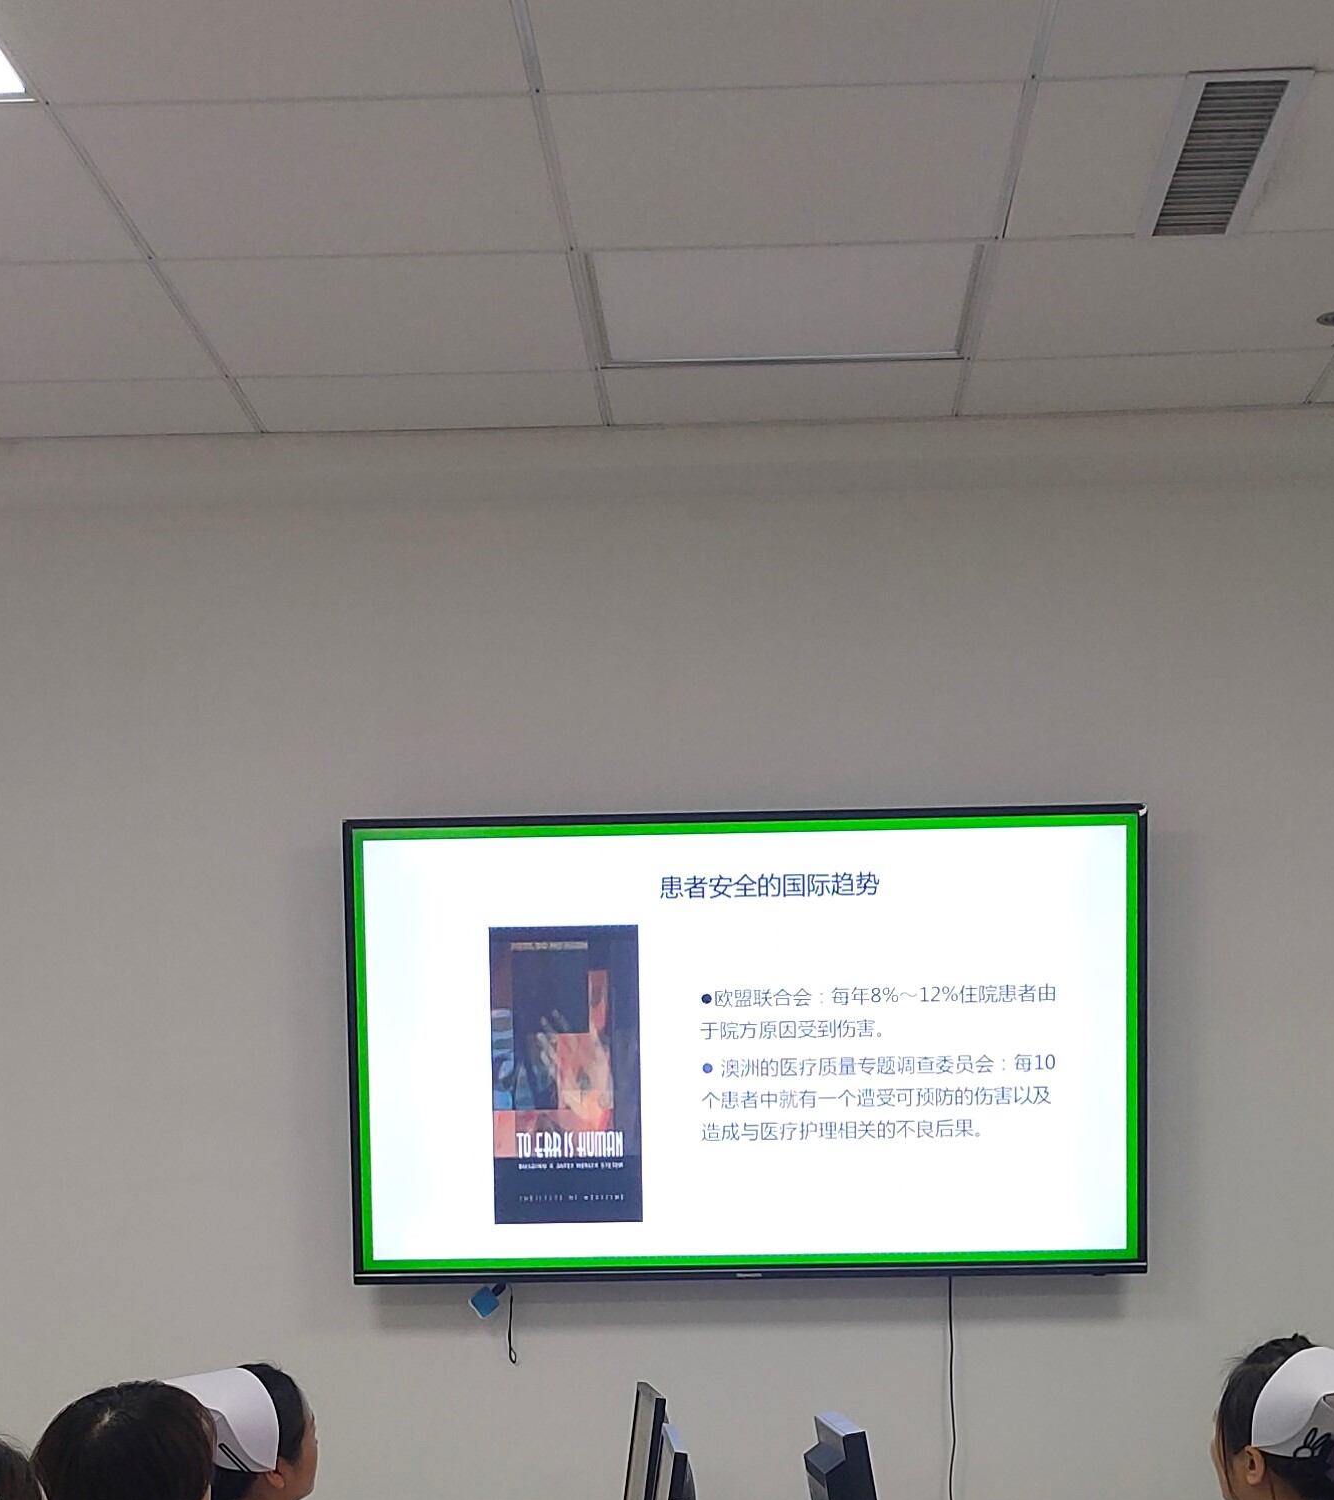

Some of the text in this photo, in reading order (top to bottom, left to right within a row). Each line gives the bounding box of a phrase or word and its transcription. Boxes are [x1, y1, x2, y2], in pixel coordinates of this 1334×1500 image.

[660, 871, 880, 899] 患者安全的国际趋势
[700, 1019, 882, 1040] 于院方原因受到伤害。
[701, 1085, 1052, 1109] 个患者中就有一个遭受可预防的伤害以及
[701, 1118, 981, 1141] 造成与医疗护理相关的不良后果。
[516, 1131, 624, 1158] TO ERR IS HUMAN
